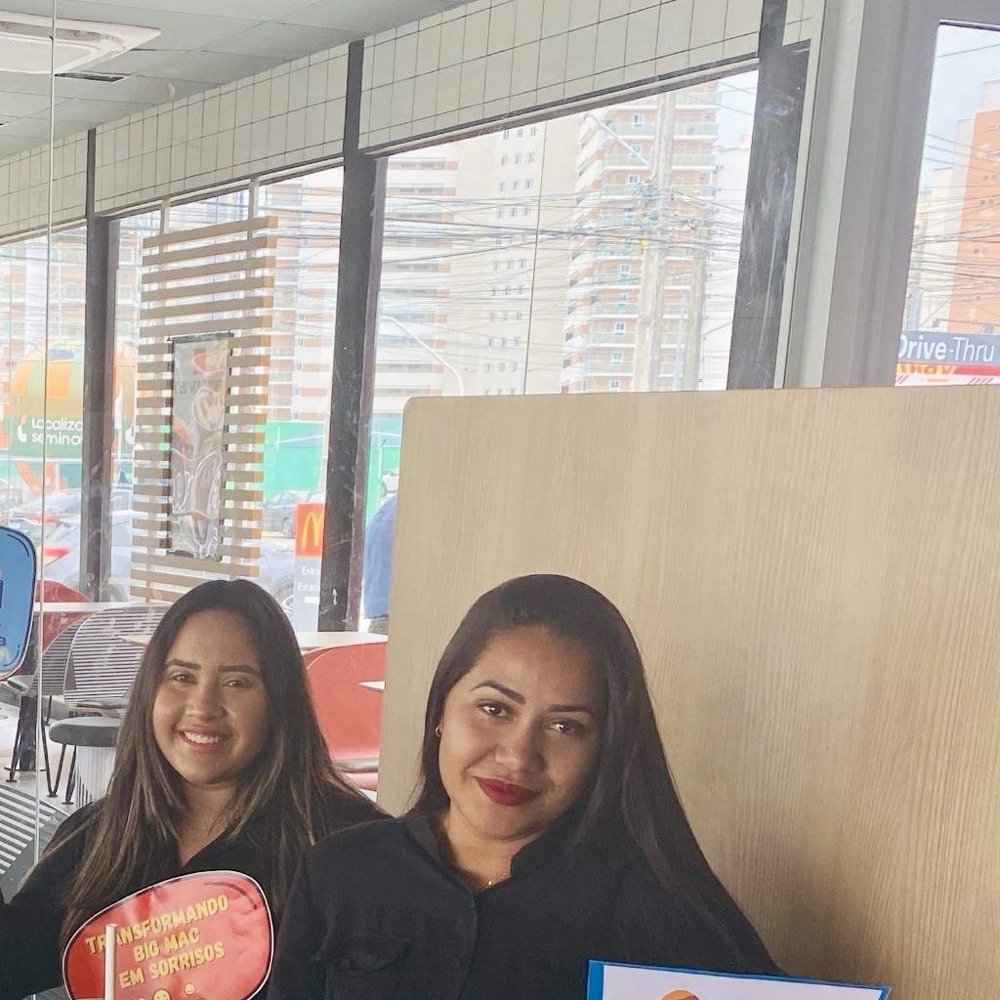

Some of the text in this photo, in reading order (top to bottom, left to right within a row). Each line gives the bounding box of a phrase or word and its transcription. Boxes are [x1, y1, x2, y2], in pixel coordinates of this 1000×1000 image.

[117, 941, 226, 989] EM SORRISOS
[132, 926, 200, 963] BIG MAC
